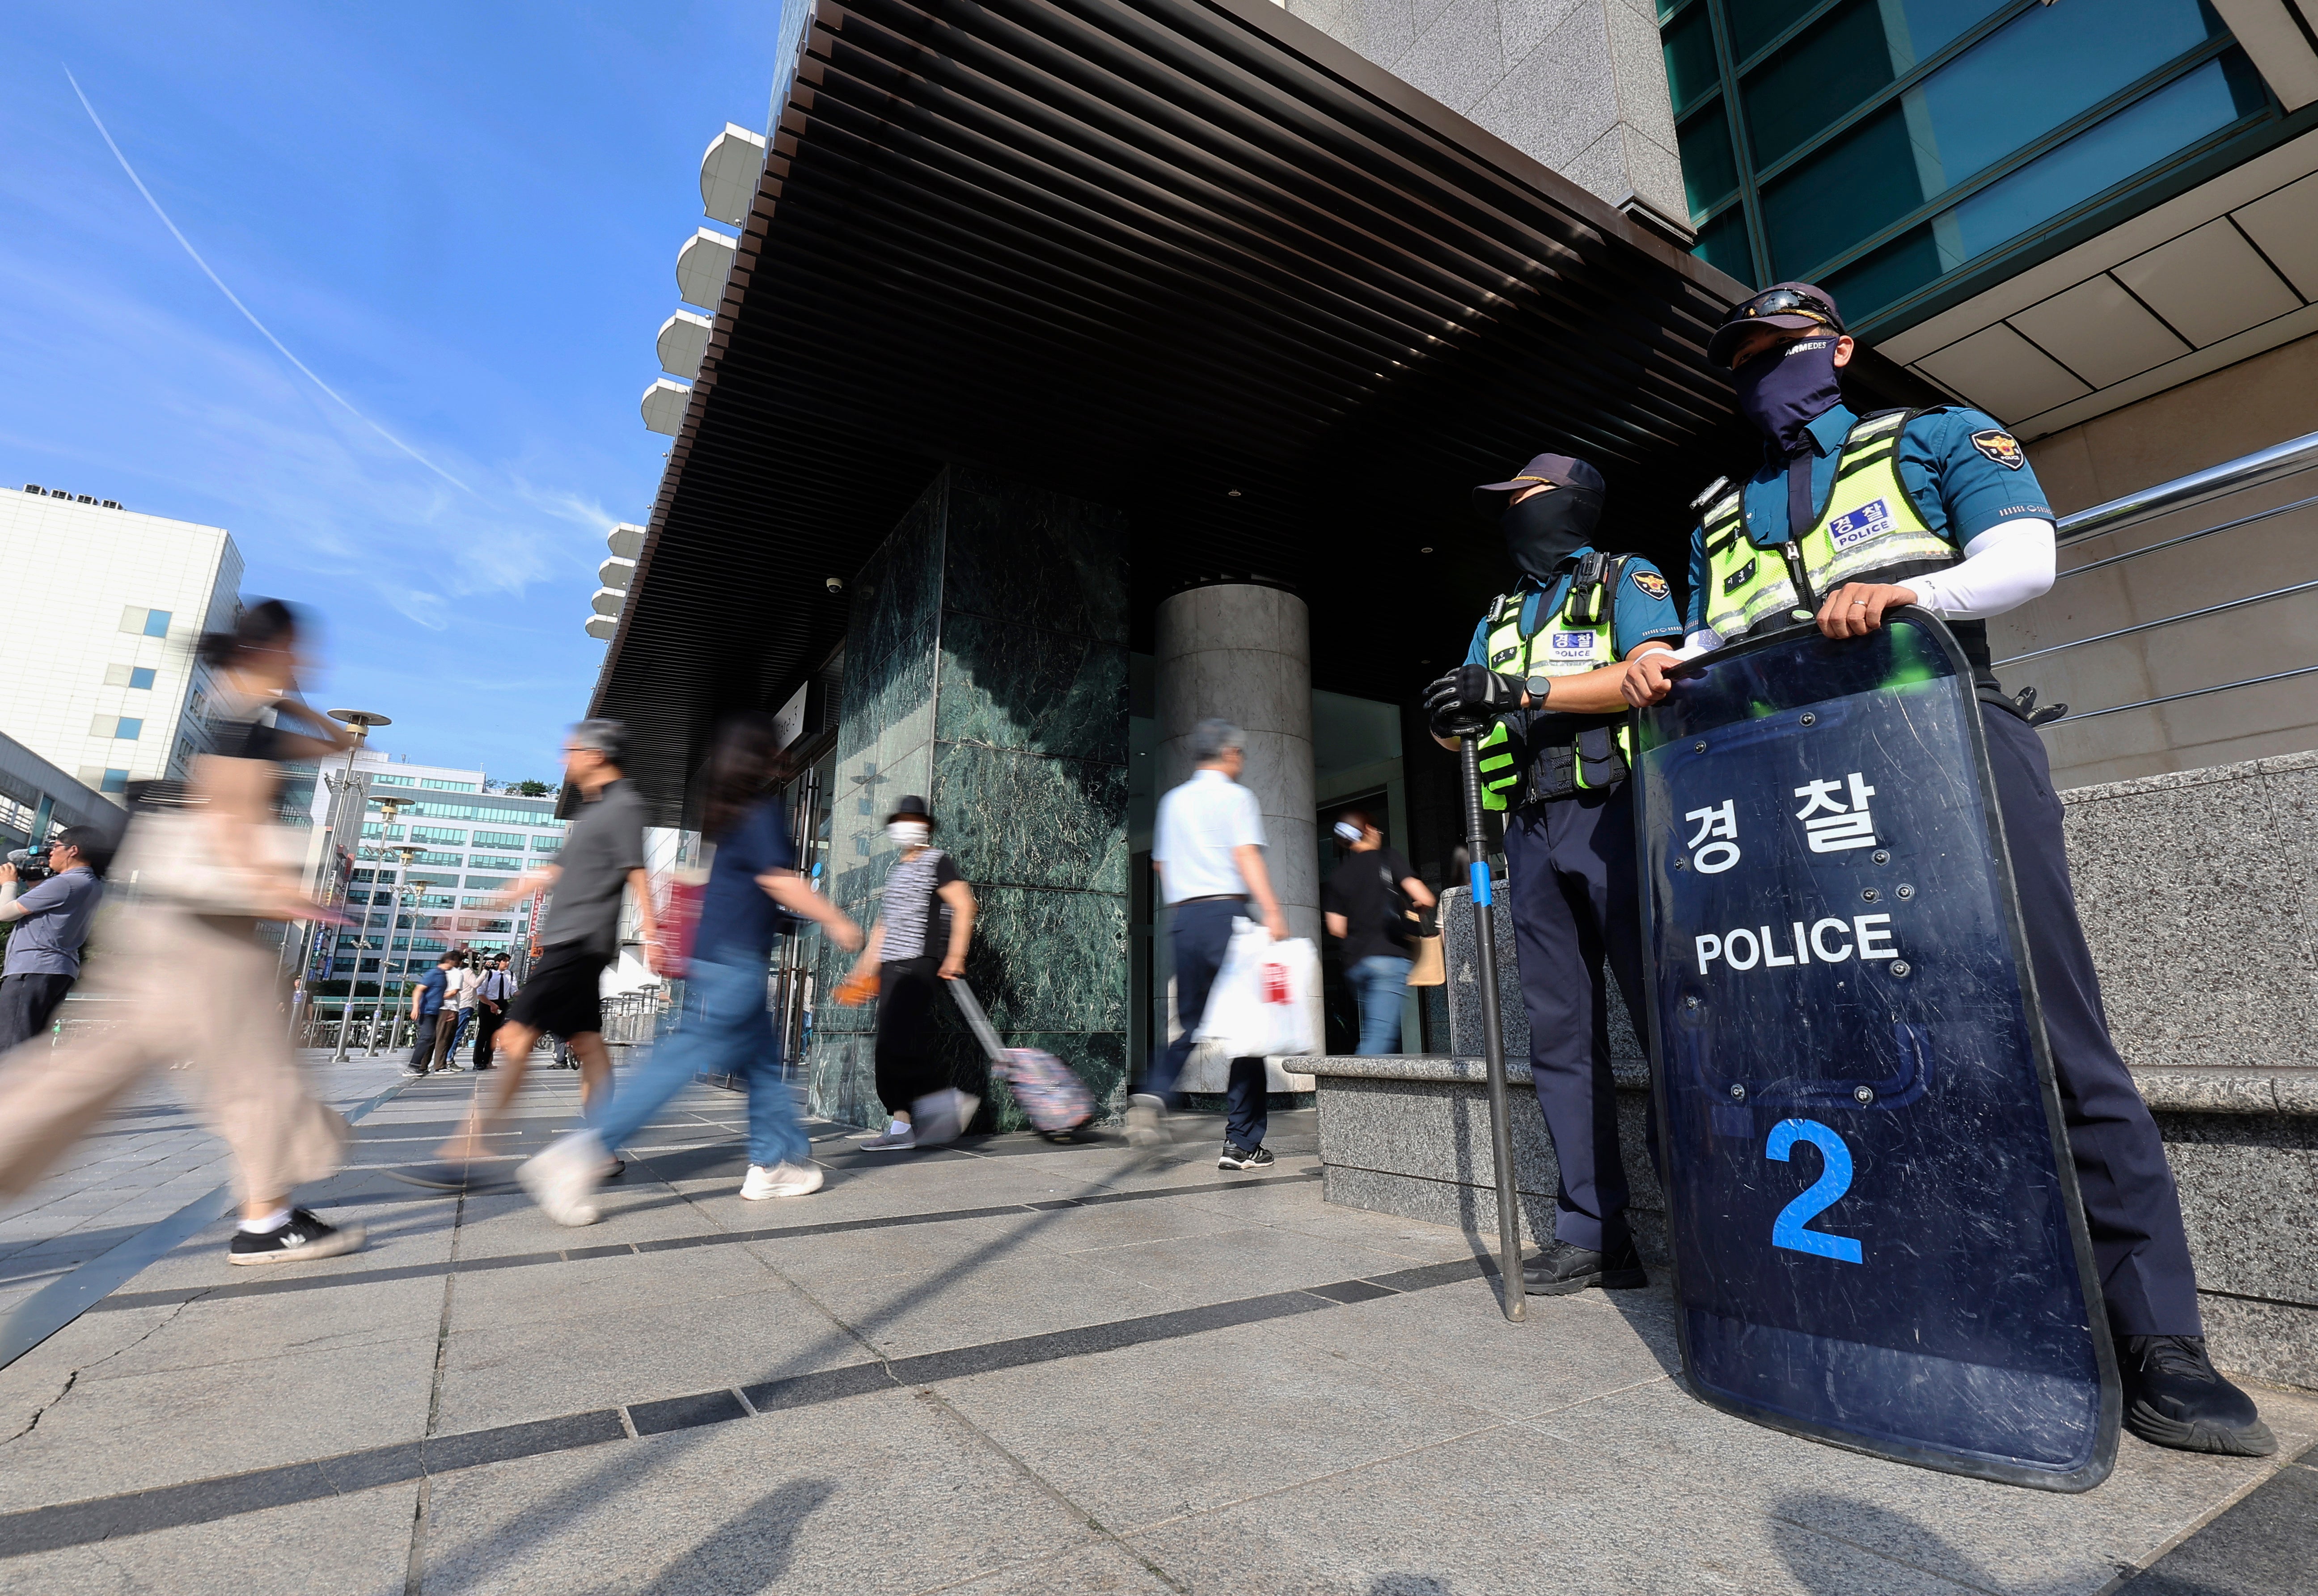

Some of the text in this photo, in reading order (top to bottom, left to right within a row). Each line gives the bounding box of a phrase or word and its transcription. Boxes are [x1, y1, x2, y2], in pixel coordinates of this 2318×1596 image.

[1785, 342, 1827, 356] ARMEDES
[1839, 521, 1889, 546] POLICE
[792, 705, 798, 726] 3
[1695, 913, 1899, 975] POLICE
[1766, 1118, 1863, 1264] 2
